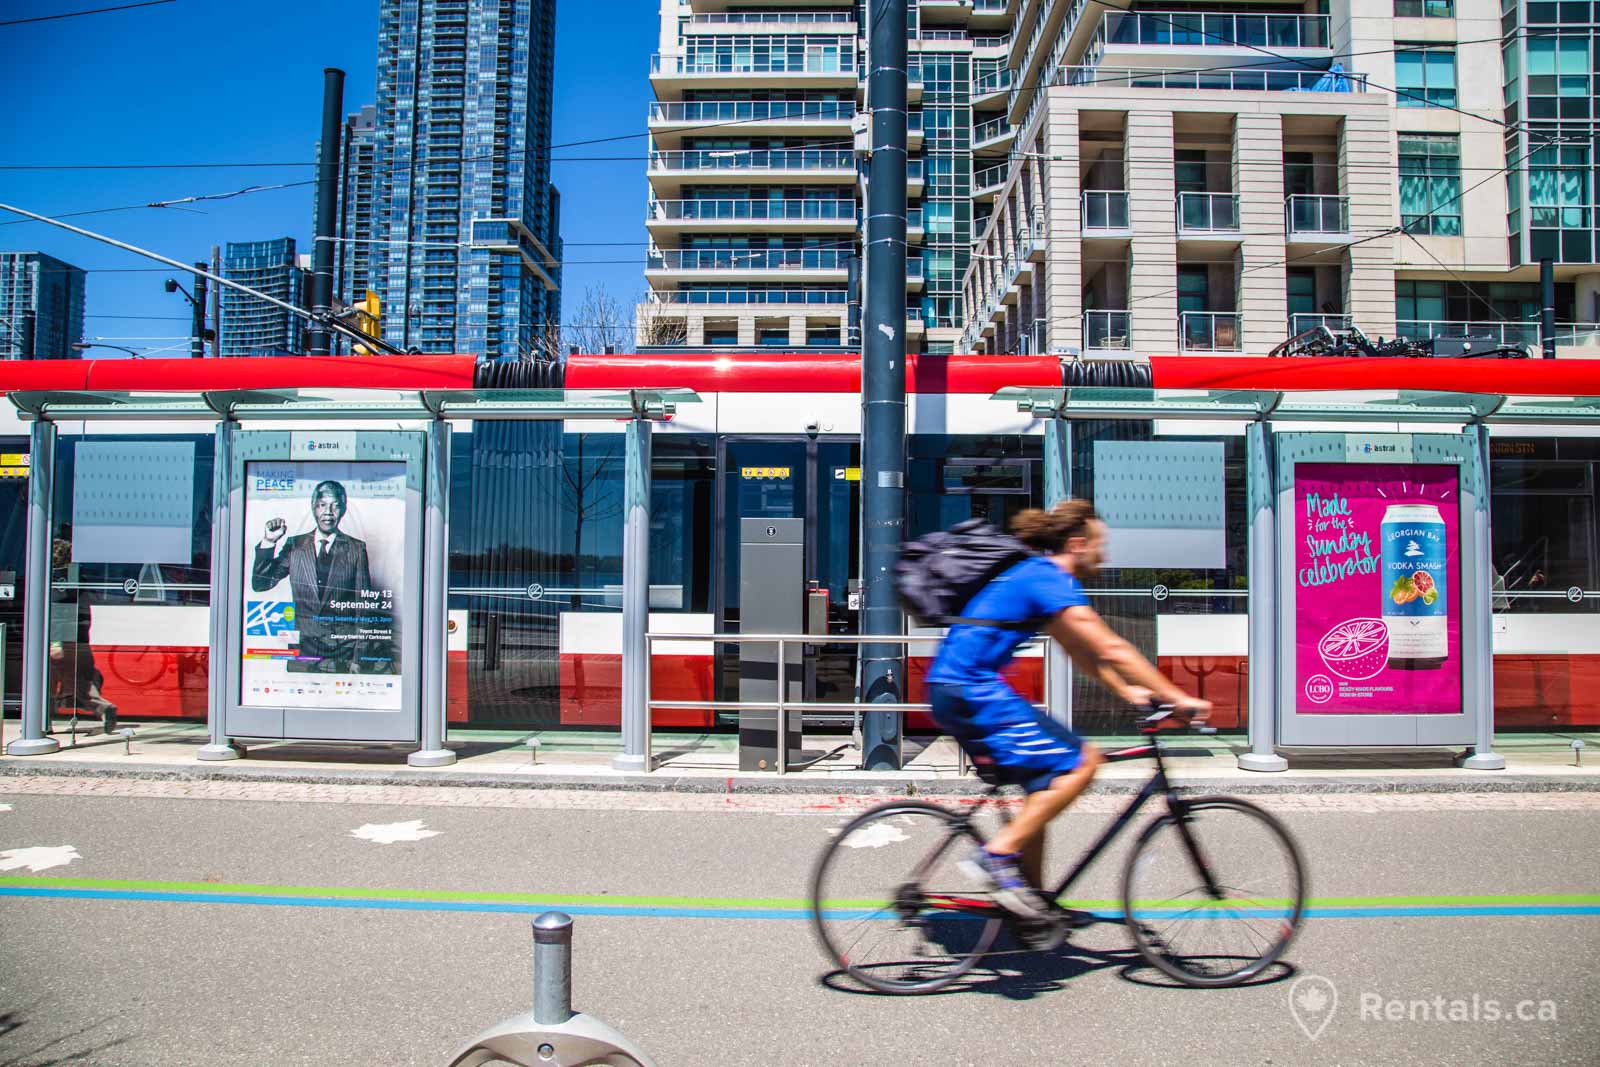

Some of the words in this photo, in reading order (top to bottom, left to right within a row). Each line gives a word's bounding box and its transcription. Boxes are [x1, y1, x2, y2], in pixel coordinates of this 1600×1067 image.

[256, 470, 294, 479] MAKING
[256, 479, 294, 488] PEACE
[1306, 492, 1352, 517] Made
[1315, 518, 1330, 533] for
[1331, 517, 1347, 530] the
[1387, 528, 1425, 543] GEORGIAN
[1427, 532, 1441, 544] BAY
[1306, 527, 1373, 559] Sunday
[1299, 550, 1382, 587] celebrator
[1387, 562, 1414, 570] VODKA
[1416, 562, 1442, 570] SMASH
[360, 590, 380, 600] May
[382, 590, 393, 598] 13
[330, 601, 379, 610] September
[381, 601, 392, 609] 24
[1309, 685, 1331, 694] LCBO
